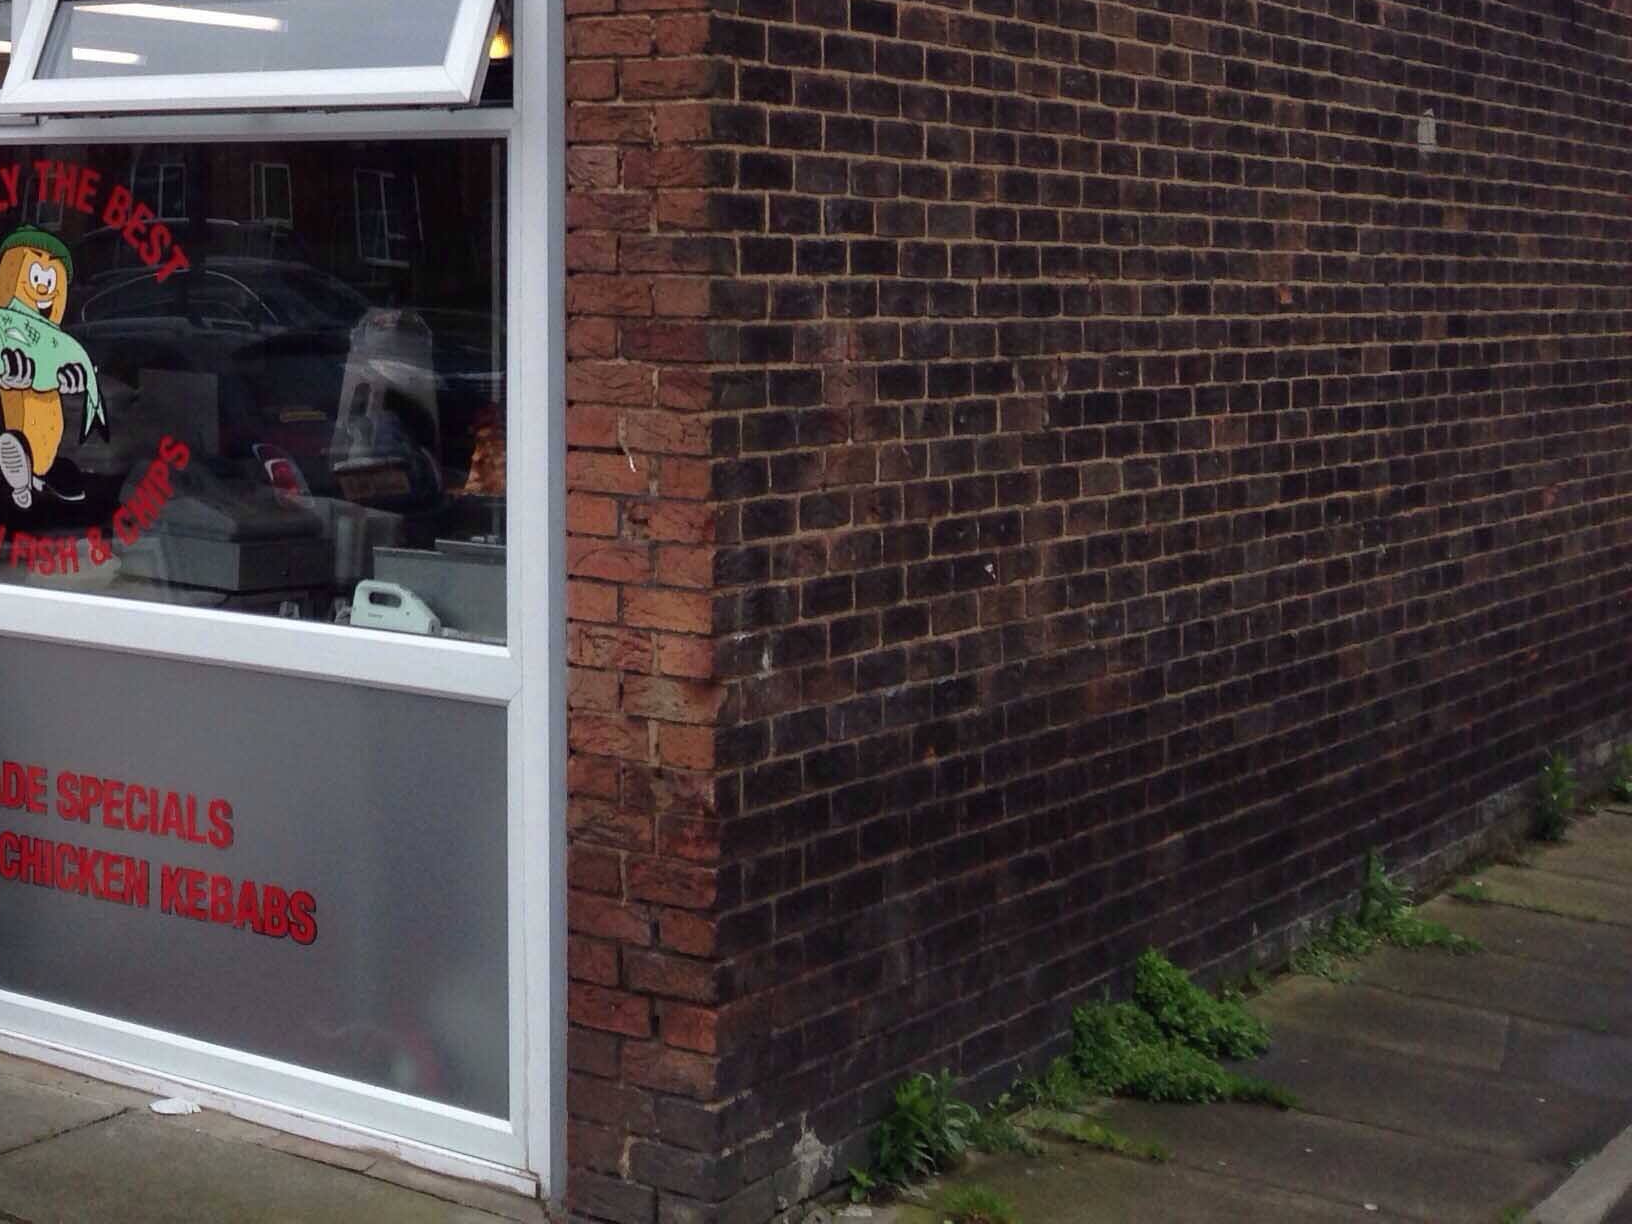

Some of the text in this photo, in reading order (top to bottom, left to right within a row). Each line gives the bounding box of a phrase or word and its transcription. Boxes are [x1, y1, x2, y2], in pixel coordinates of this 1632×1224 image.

[33, 160, 101, 214] THE
[102, 184, 191, 283] BEST
[10, 531, 80, 575] FISH
[87, 526, 113, 566] &
[112, 434, 191, 546] CHIPS
[56, 770, 235, 849] SPECIALS
[161, 866, 318, 945] KEBABS
